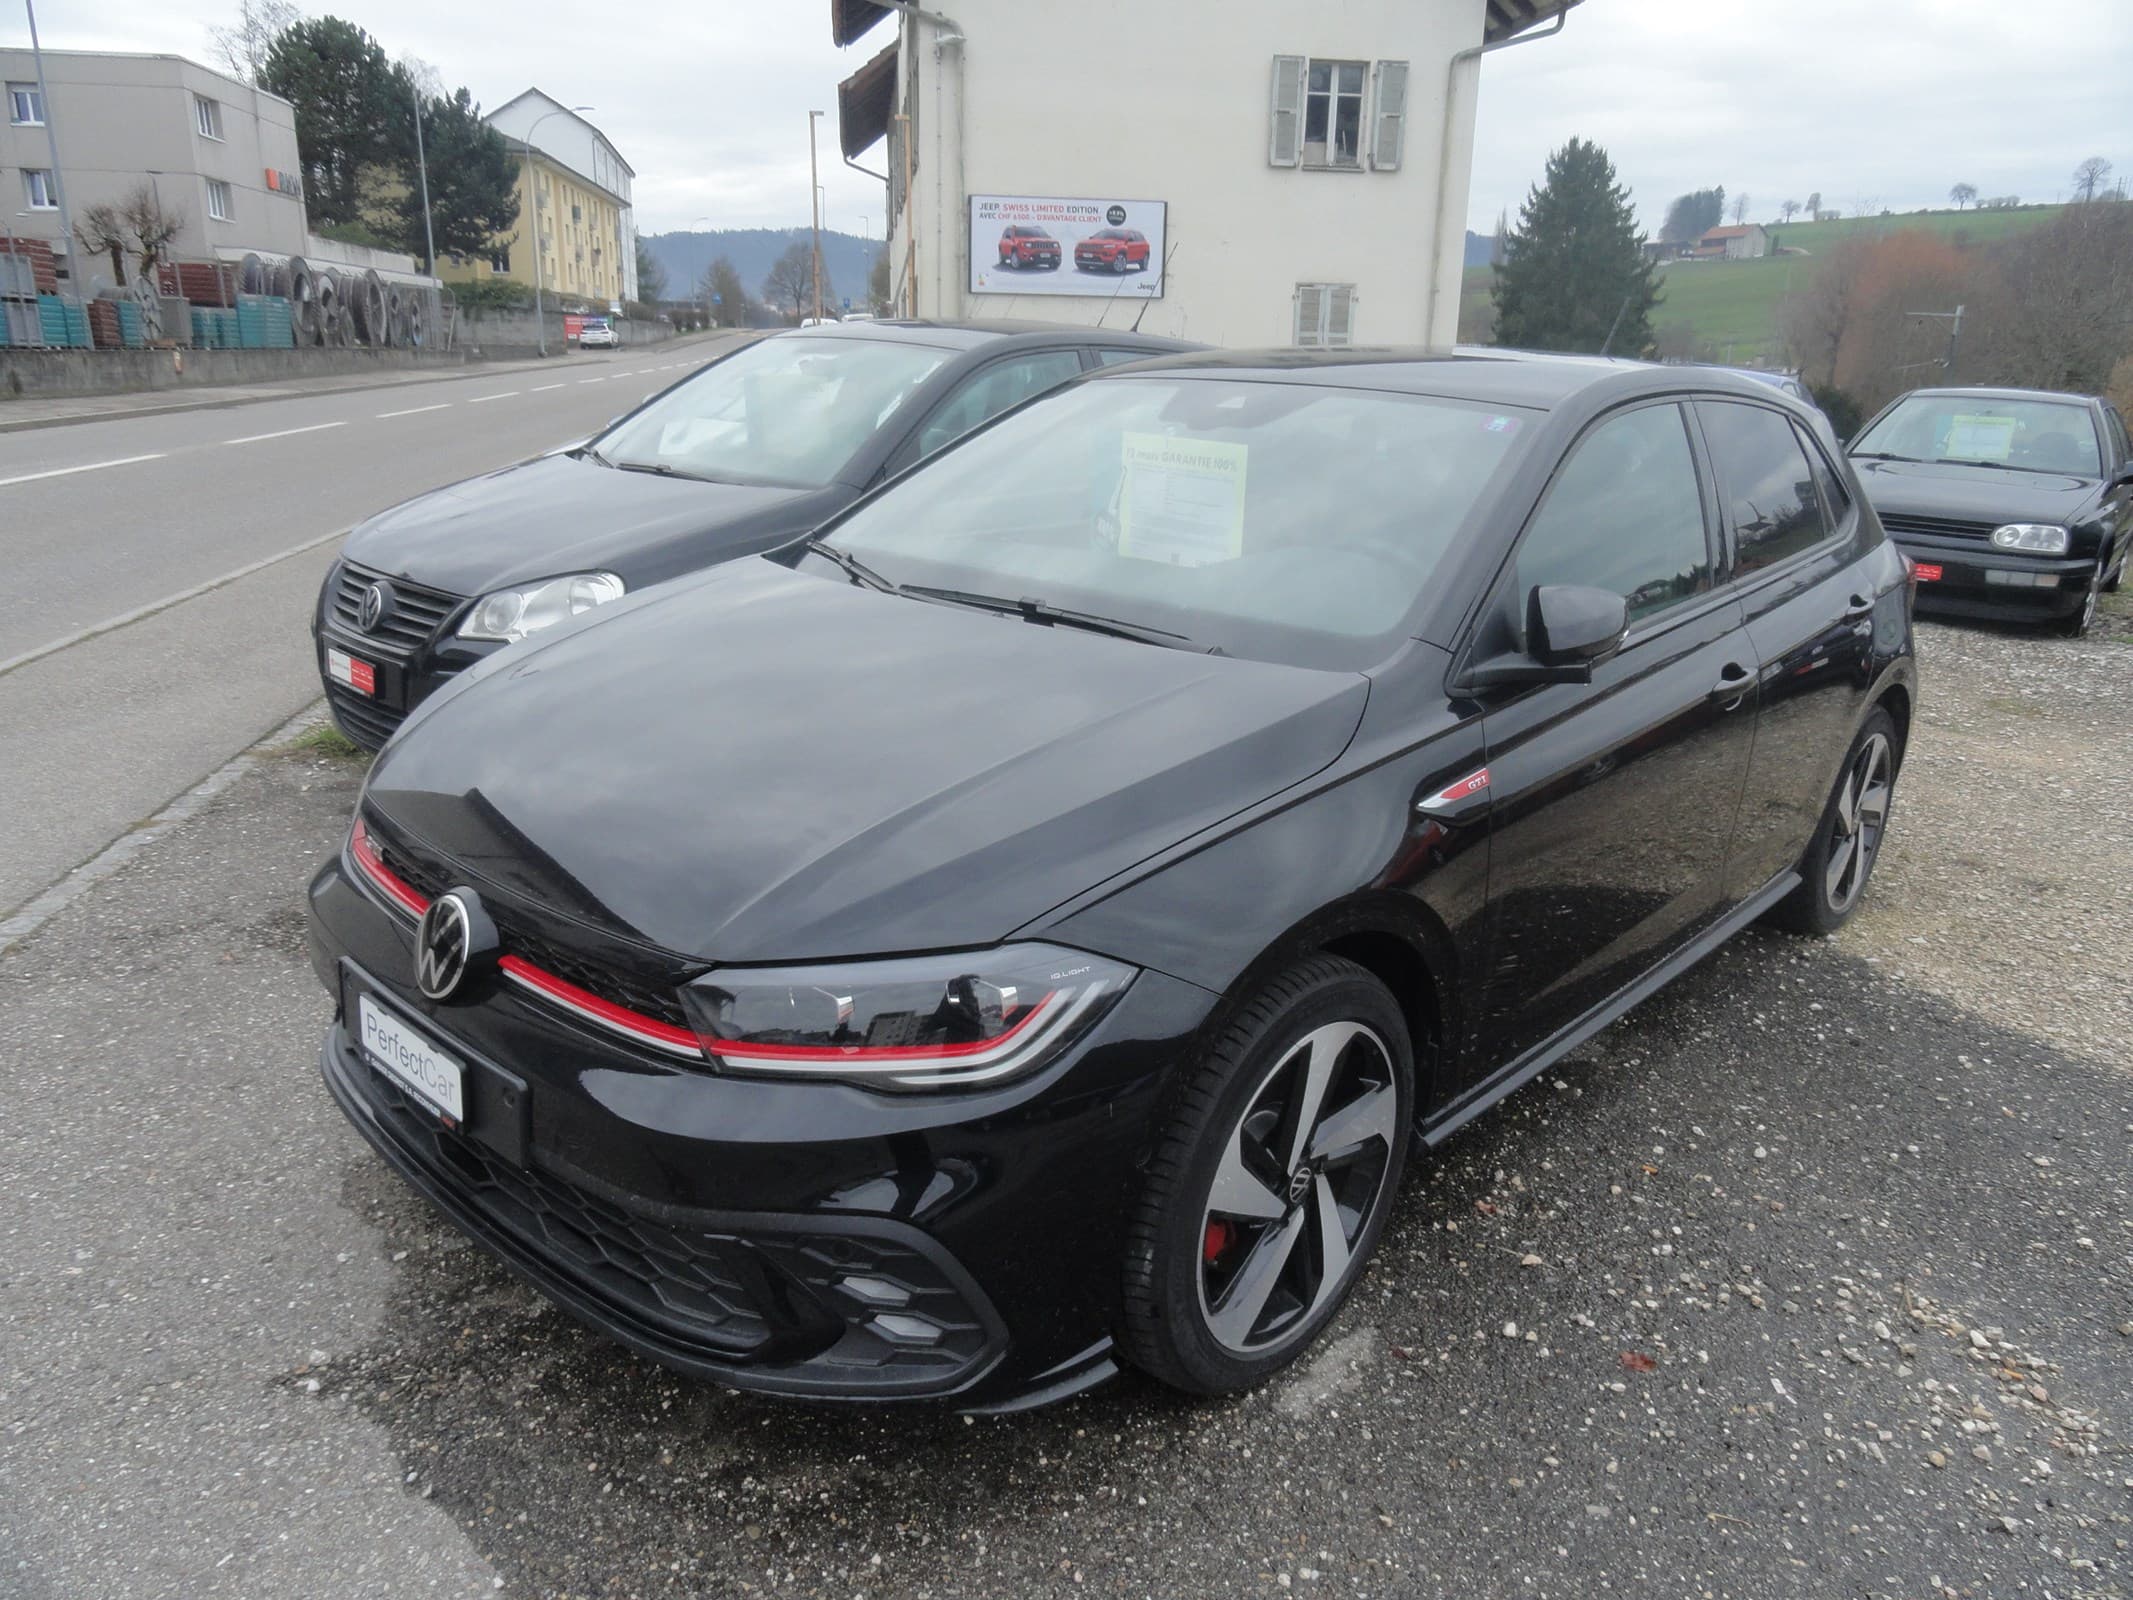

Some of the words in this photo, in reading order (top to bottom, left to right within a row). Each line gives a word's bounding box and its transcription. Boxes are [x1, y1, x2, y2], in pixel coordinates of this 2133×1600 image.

[1003, 203, 1030, 212] SWISS
[1031, 204, 1065, 213] LIMITED
[1066, 205, 1099, 214] EDITION
[979, 212, 996, 220] AVEC
[1137, 282, 1155, 292] Jeep
[1161, 451, 1212, 468] GARANTIE
[1467, 775, 1487, 790] GTI
[366, 1010, 455, 1102] PerfectCar
